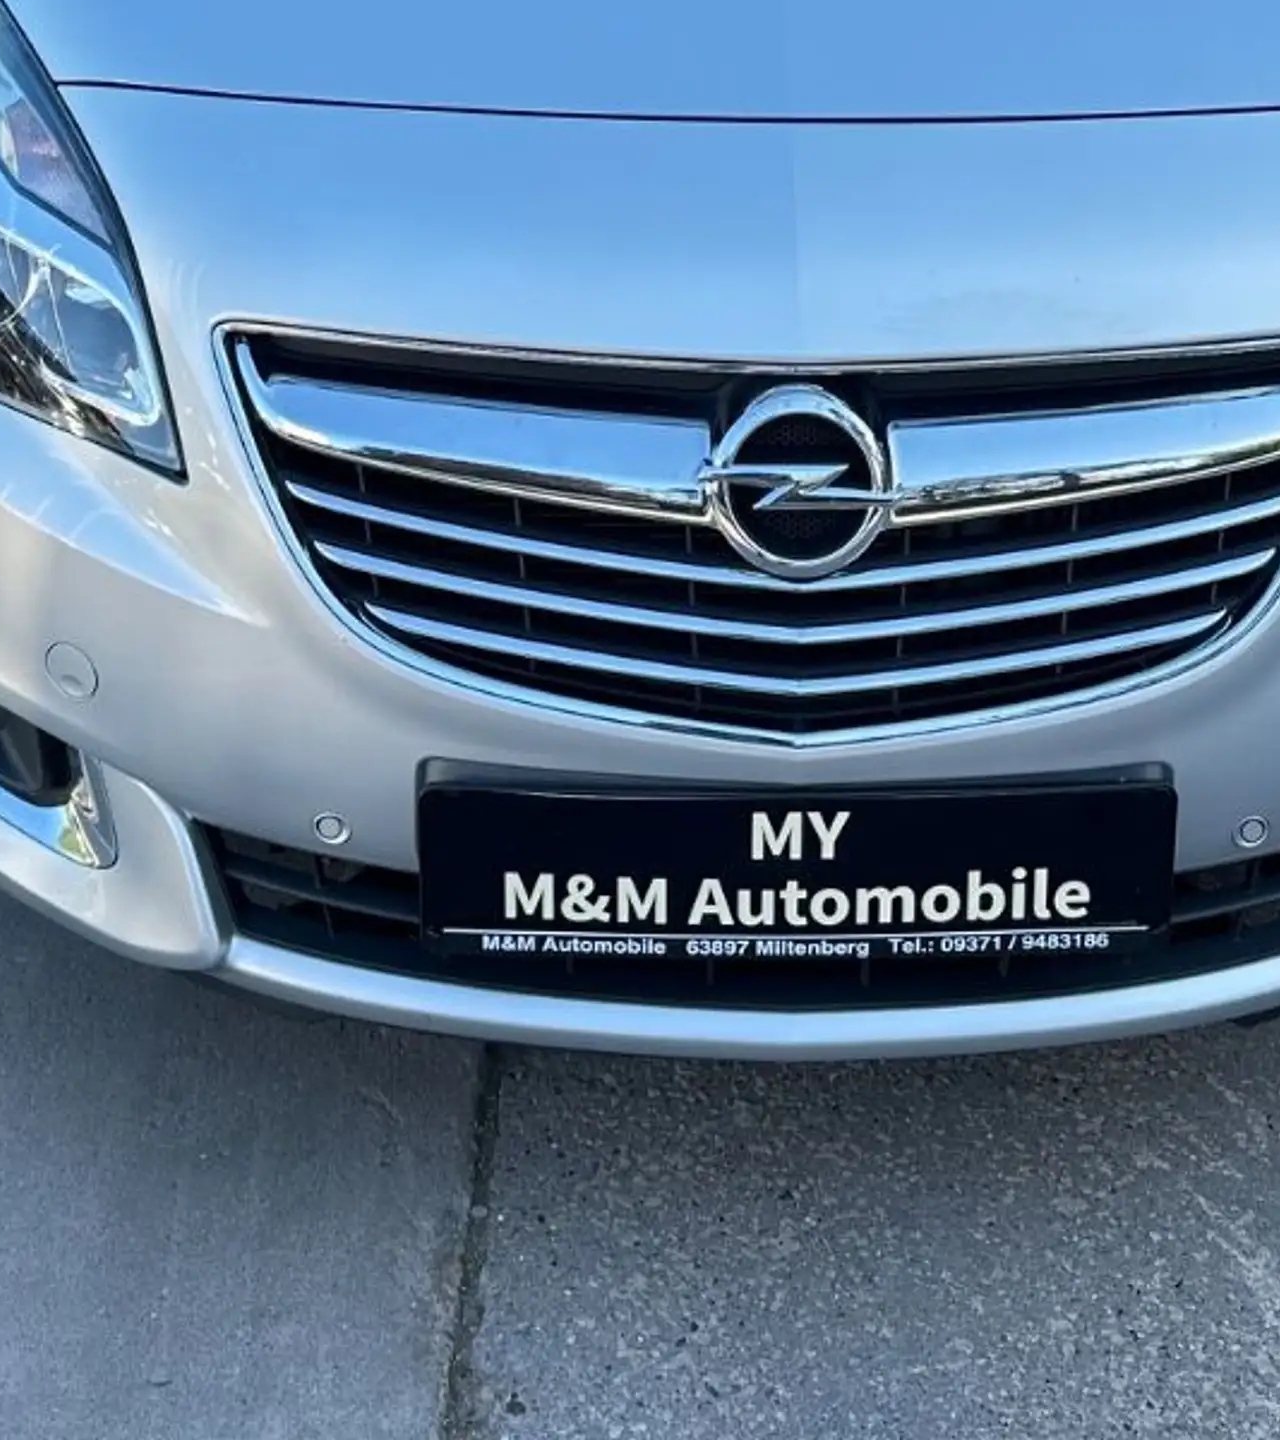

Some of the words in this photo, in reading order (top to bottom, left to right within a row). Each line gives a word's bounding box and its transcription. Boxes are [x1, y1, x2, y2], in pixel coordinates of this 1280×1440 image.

[750, 811, 851, 861] MY
[503, 871, 668, 925] M&M
[687, 866, 1092, 926] Automobile
[481, 935, 536, 952] M&M
[542, 936, 668, 956] Automobile
[686, 940, 750, 957] 63897
[755, 939, 870, 959] Miltenberg
[888, 937, 935, 953] Tel.:
[940, 935, 1002, 953] 09371
[1021, 933, 1110, 951] 9483186
